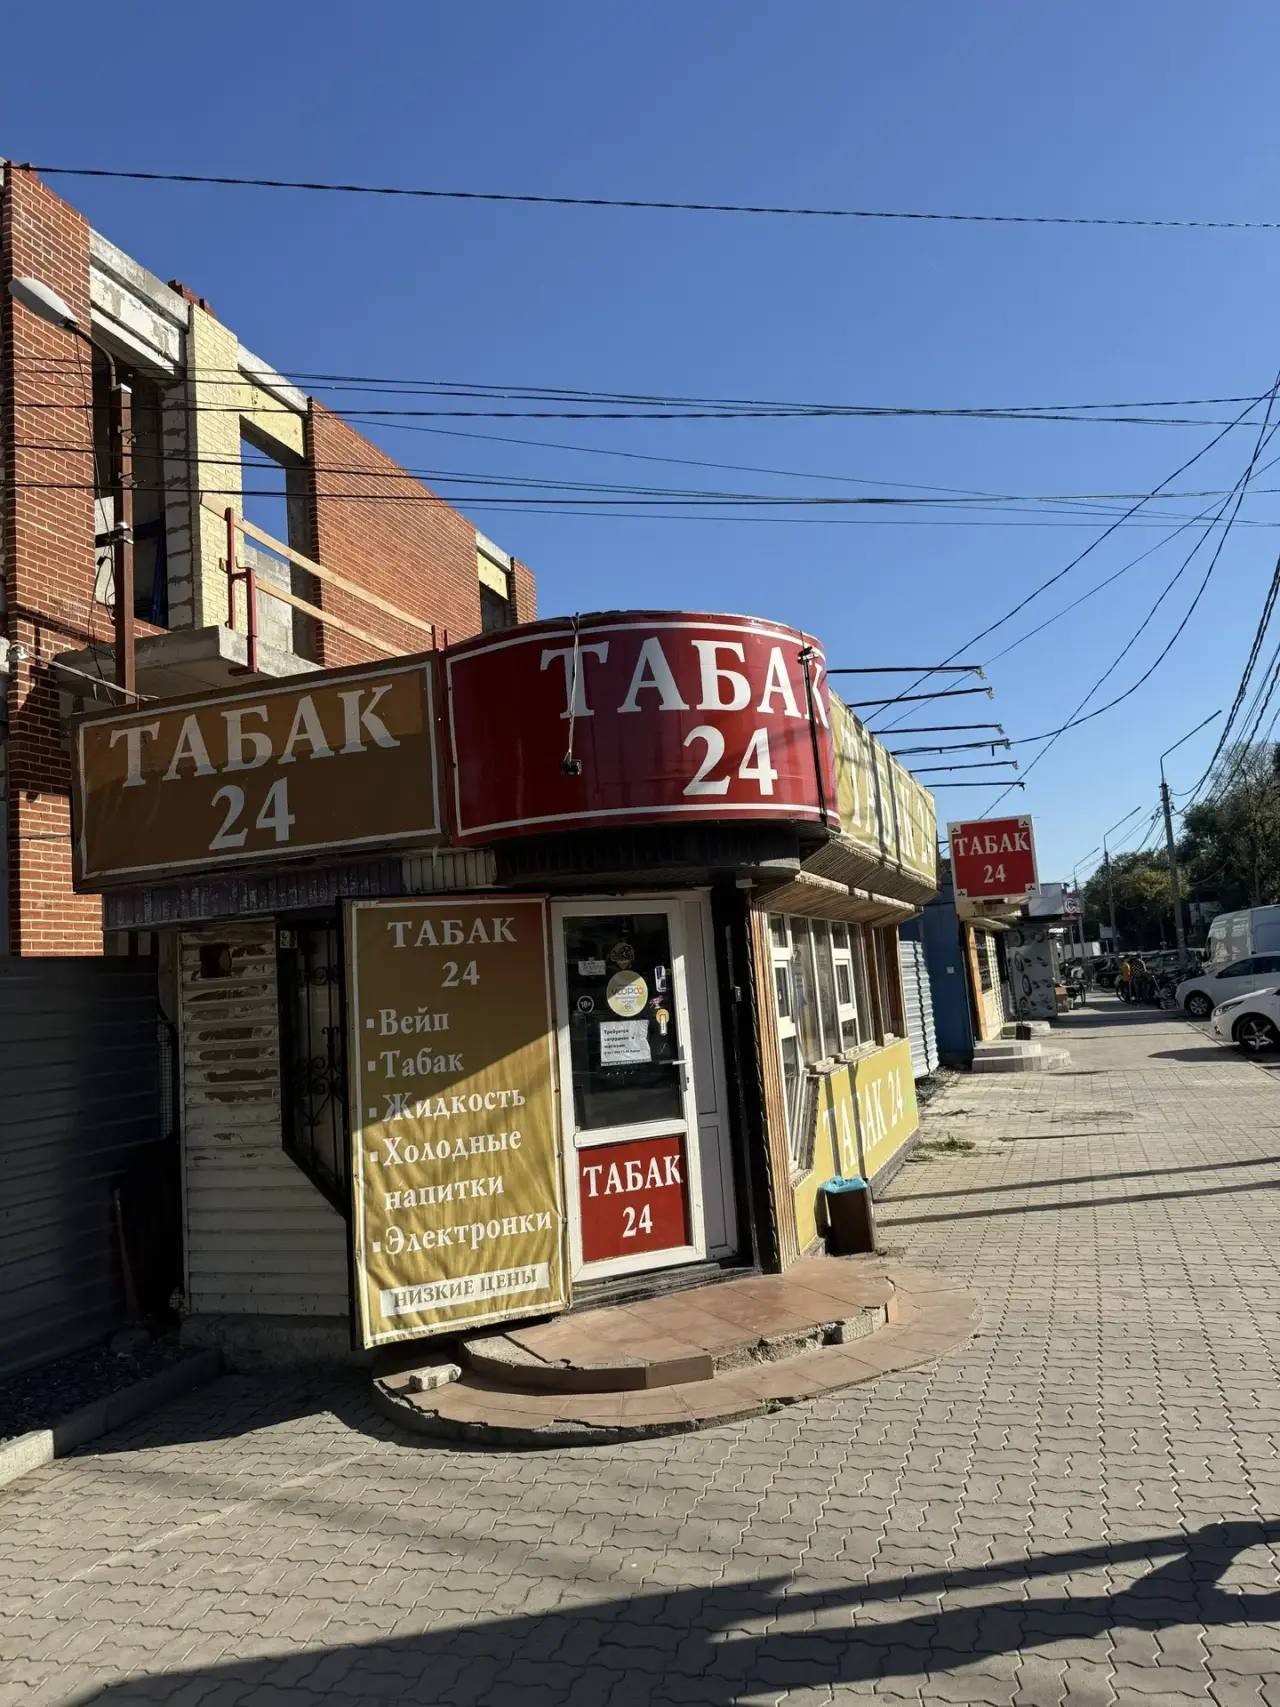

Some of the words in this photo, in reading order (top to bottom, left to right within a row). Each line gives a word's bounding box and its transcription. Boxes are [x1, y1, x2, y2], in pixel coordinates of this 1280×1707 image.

[540, 636, 829, 729] ТАБАК
[109, 684, 400, 788] ТАБАК
[682, 725, 778, 796] 24
[209, 776, 295, 850] 24
[954, 831, 1031, 857] ТАБАК
[983, 864, 1006, 884] 24
[387, 917, 517, 948] ТАБАК
[441, 960, 480, 987] 24
[378, 1006, 450, 1036] Вейп
[380, 1047, 464, 1078] Табак
[382, 1089, 526, 1122] Жидкость
[888, 1068, 904, 1128] 24
[383, 1130, 522, 1166] Холодные
[384, 1176, 504, 1211] напитки
[583, 1155, 684, 1197] ТАБАК
[385, 1211, 552, 1255] Электронки
[622, 1204, 653, 1238] 24
[394, 1279, 474, 1307] НИЗКИЕ
[480, 1269, 537, 1293] ЦЕНЫ
